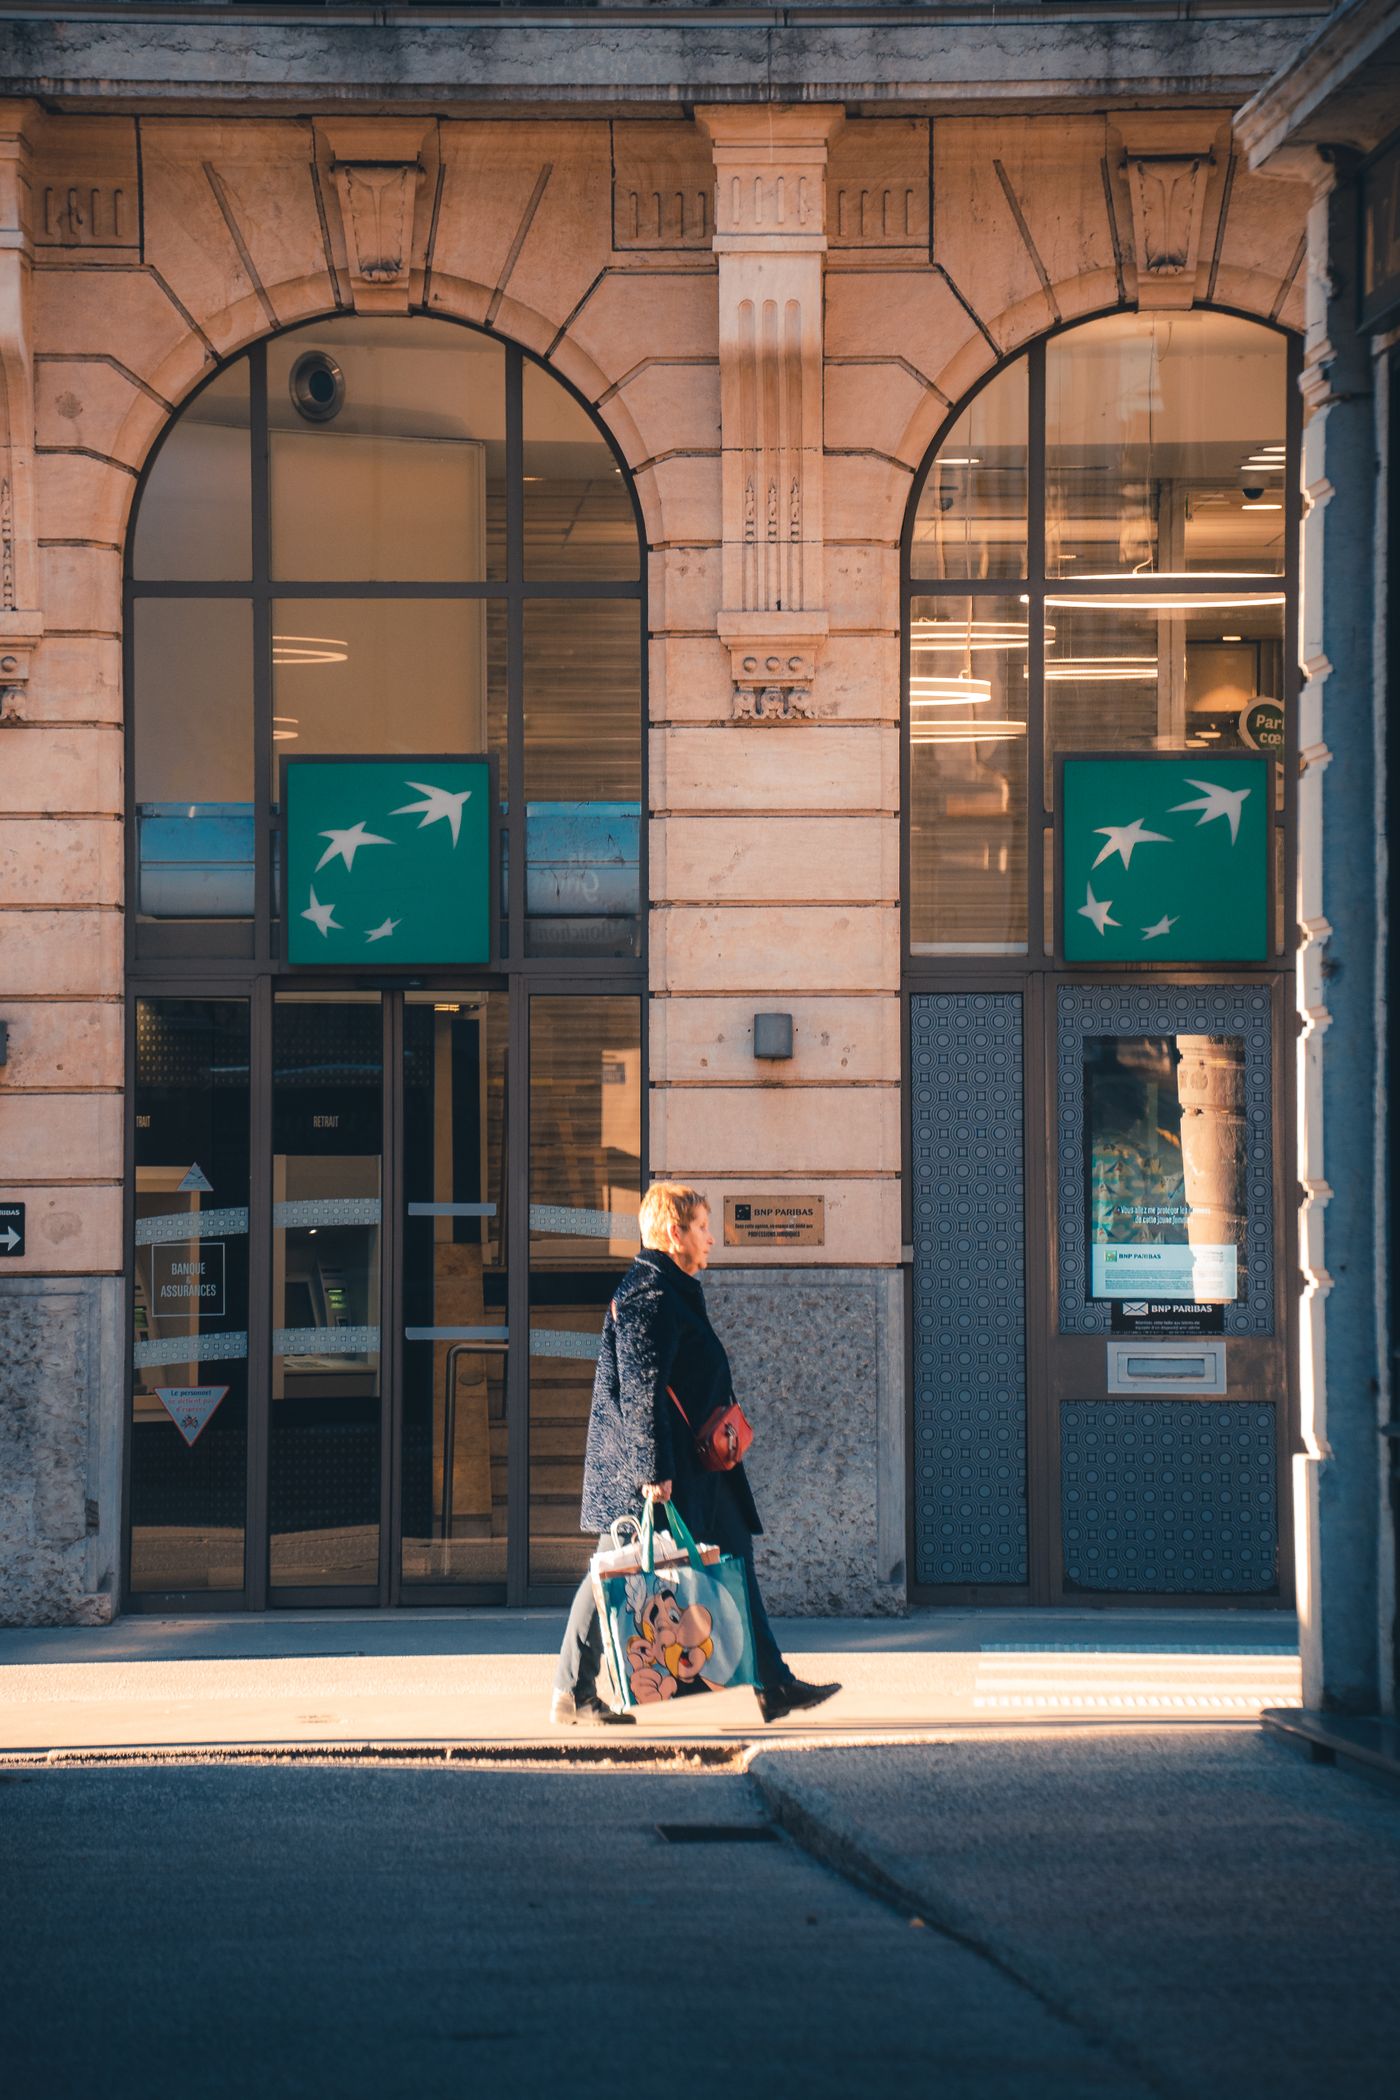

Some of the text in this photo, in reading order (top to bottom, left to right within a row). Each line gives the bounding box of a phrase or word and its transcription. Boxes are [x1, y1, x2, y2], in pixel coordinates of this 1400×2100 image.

[1256, 714, 1284, 730] Par
[1259, 732, 1284, 745] cœ
[313, 1115, 339, 1128] RETRAIT
[754, 1208, 814, 1216] BNP PARIBAS
[171, 1262, 206, 1276] BANQUE
[160, 1284, 216, 1298] ASSURANCES
[1151, 1304, 1213, 1313] BNP PARIBAS
